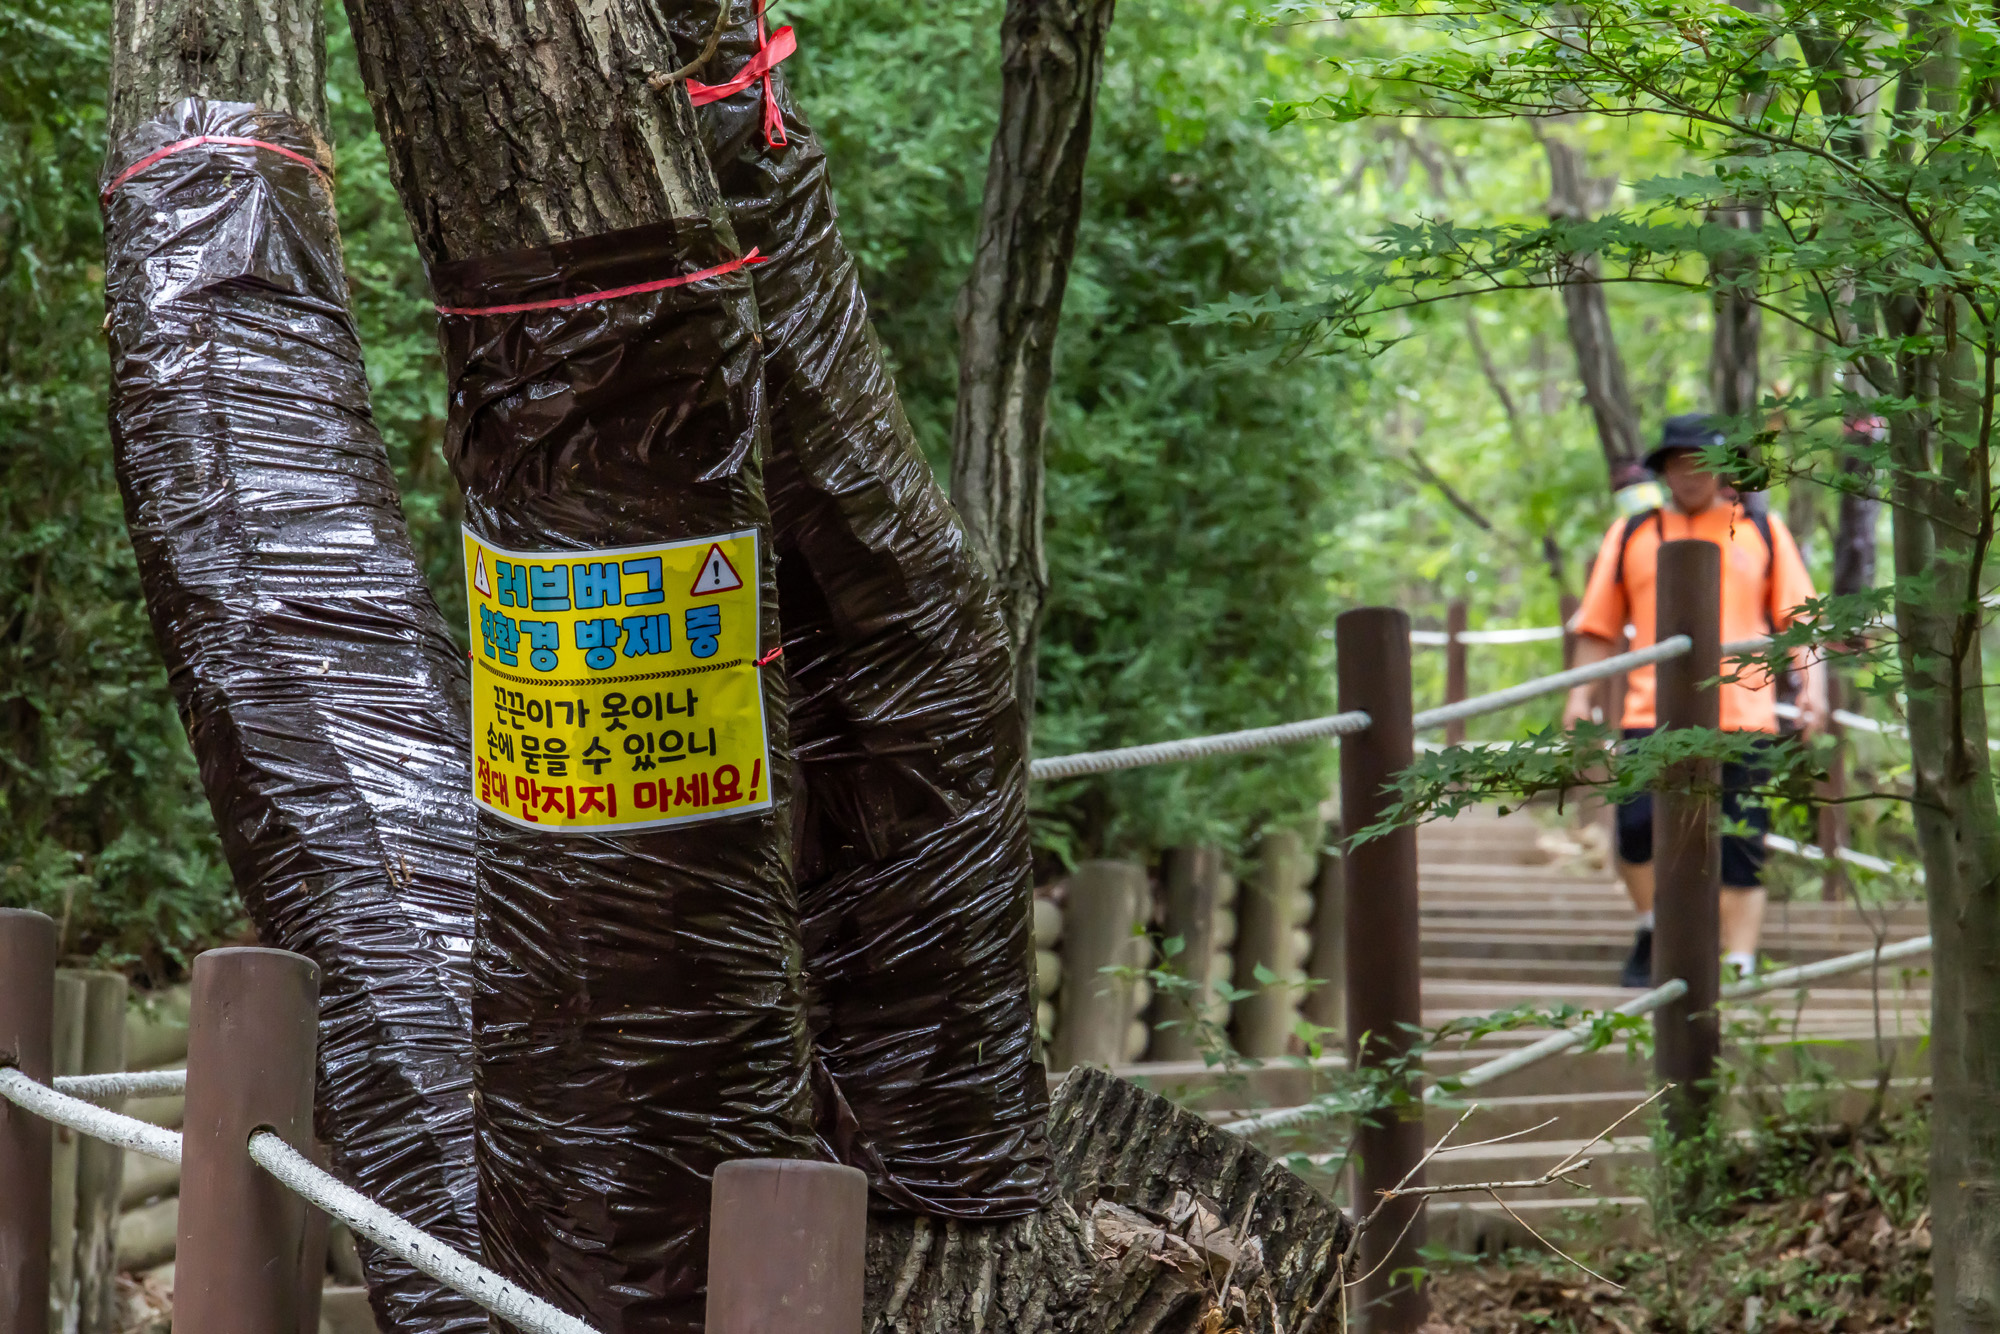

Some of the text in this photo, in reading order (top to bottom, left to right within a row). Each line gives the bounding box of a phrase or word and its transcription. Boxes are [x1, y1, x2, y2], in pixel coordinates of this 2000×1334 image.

[495, 556, 665, 612] 러브버그
[479, 602, 722, 672] 친환경 방제 중
[493, 685, 698, 732] 끈끈이가 옷이나
[486, 722, 717, 777] 손에 묻을 수 있으니
[477, 755, 761, 822] 절대 만지지 마세요!
